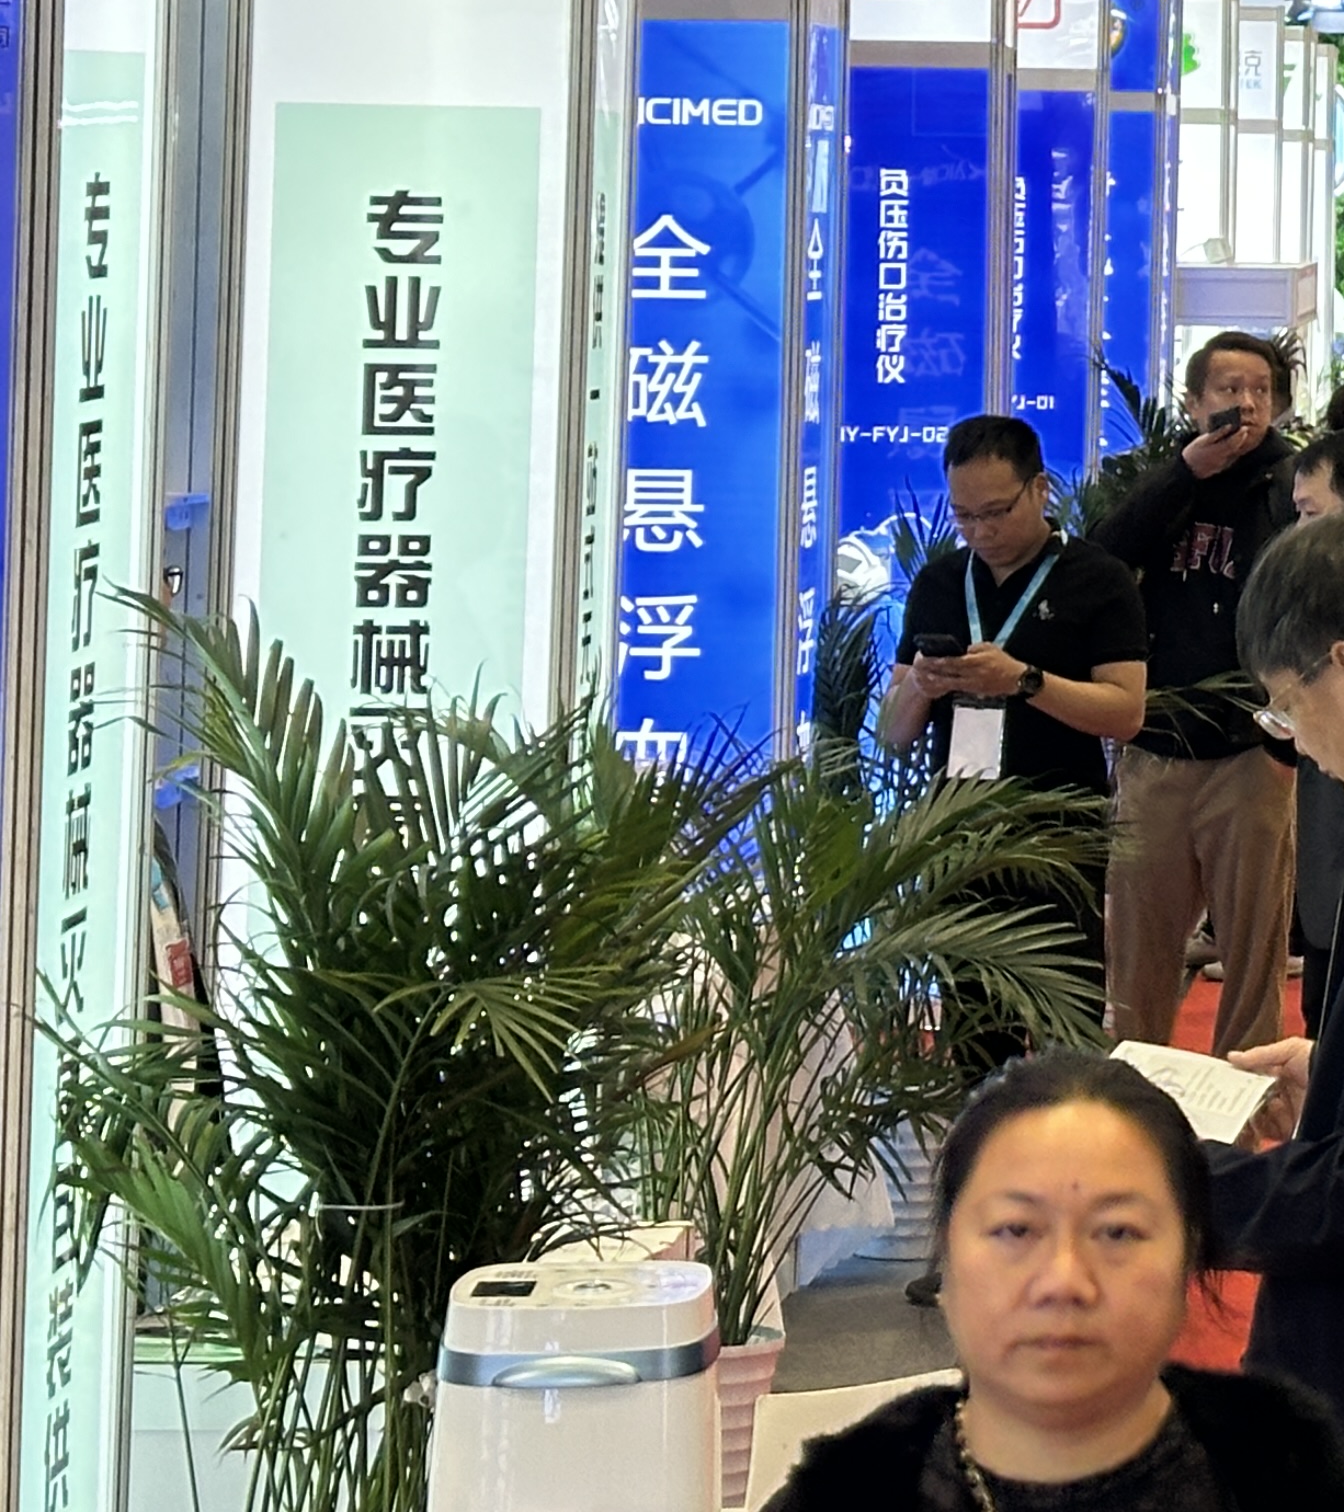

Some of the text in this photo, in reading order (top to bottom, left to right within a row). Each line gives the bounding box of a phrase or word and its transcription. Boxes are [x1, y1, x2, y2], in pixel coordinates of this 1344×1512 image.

[875, 168, 909, 384] 负压伤口治疗仪
